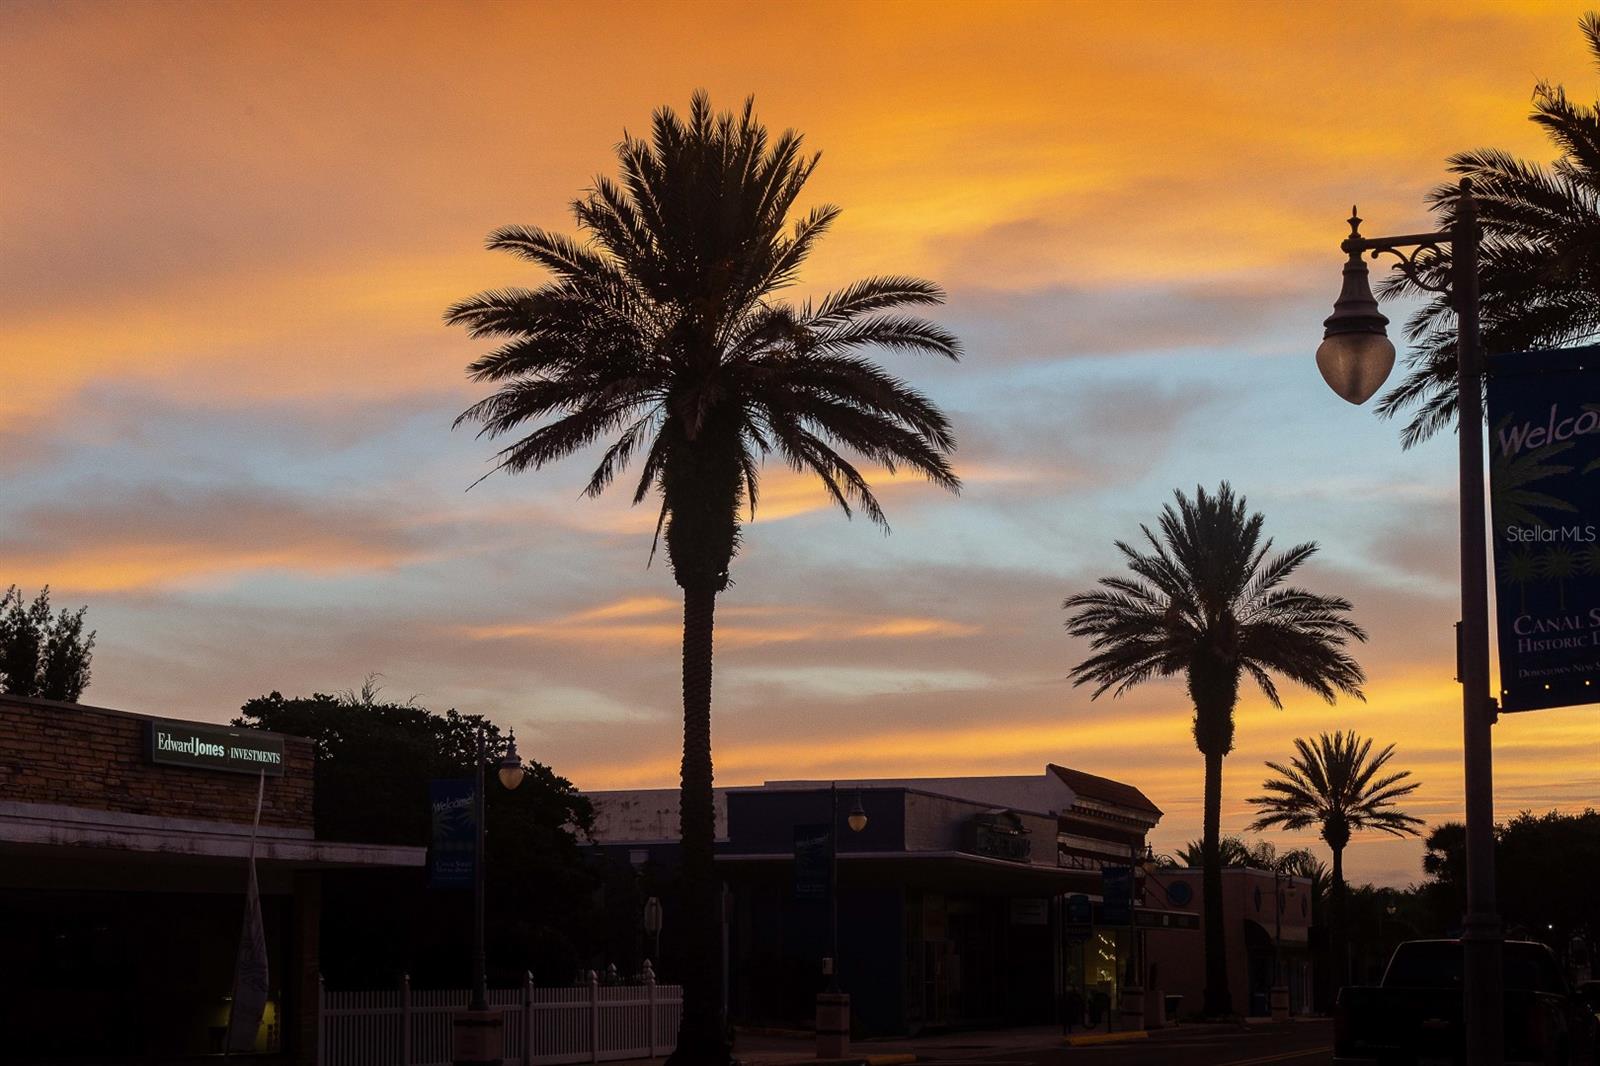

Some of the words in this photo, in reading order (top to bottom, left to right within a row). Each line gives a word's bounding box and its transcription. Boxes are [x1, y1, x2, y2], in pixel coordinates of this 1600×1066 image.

[1498, 402, 1600, 456] Welco
[1513, 614, 1585, 636] CANAL
[1518, 635, 1588, 653] HISTORIC
[230, 747, 281, 764] INVESTMENTS
